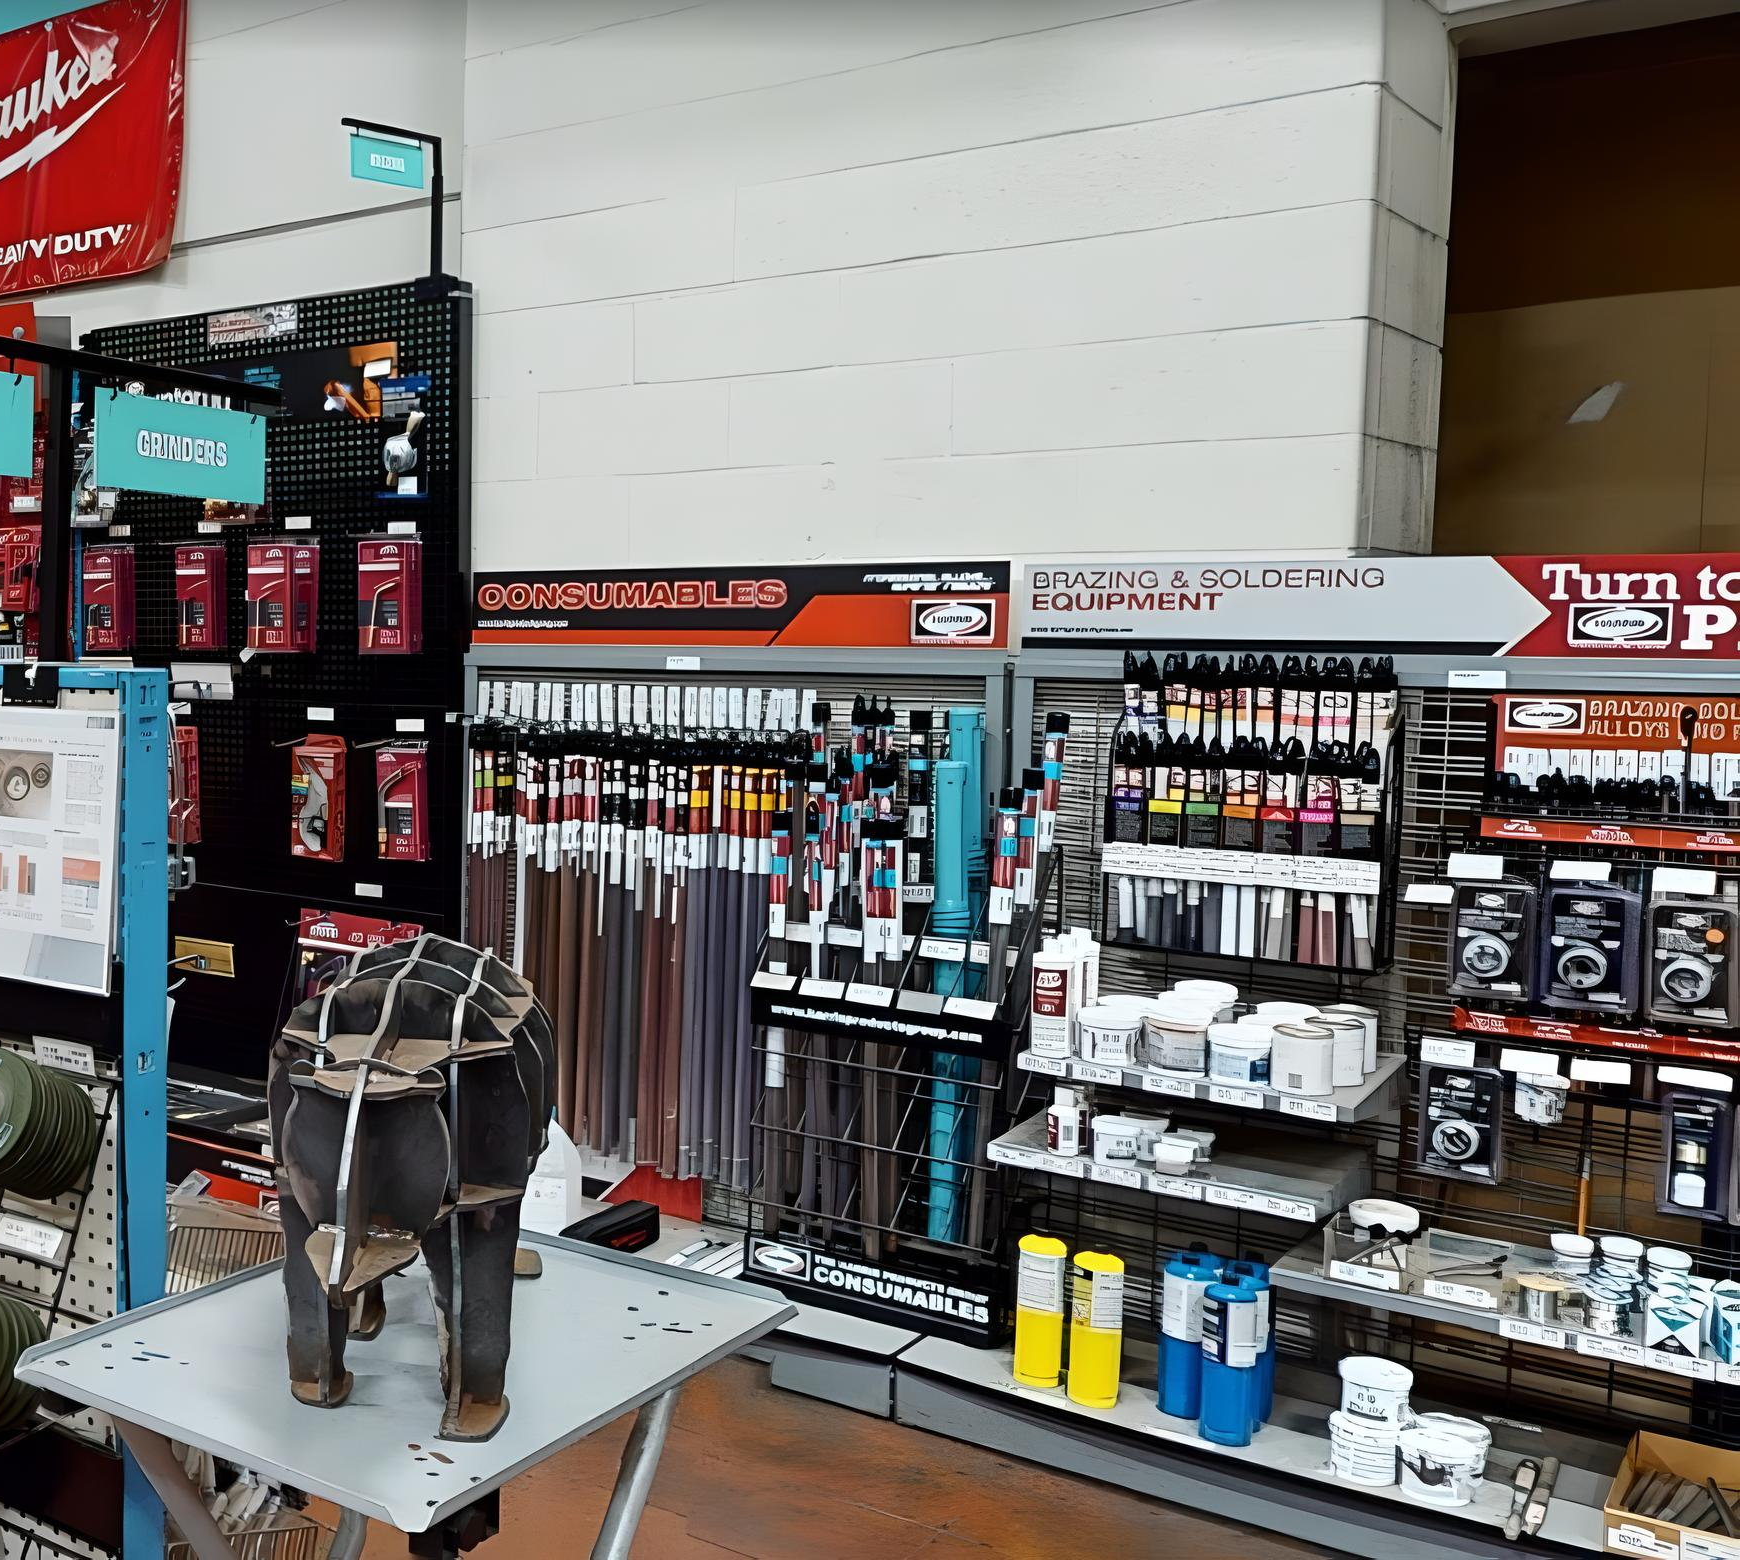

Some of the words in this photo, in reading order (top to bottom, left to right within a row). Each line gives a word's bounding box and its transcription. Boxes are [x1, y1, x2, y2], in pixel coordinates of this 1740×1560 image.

[136, 429, 228, 467] GRINDERS
[477, 579, 788, 611] CONSUMABLES
[1033, 570, 1159, 590] BRAZING
[1171, 570, 1189, 589] &
[1199, 567, 1385, 589] SOLDERING
[1542, 563, 1681, 601] Turn
[1031, 591, 1224, 612] EQUIPMENT
[812, 1266, 990, 1325] CONSUMABLES
